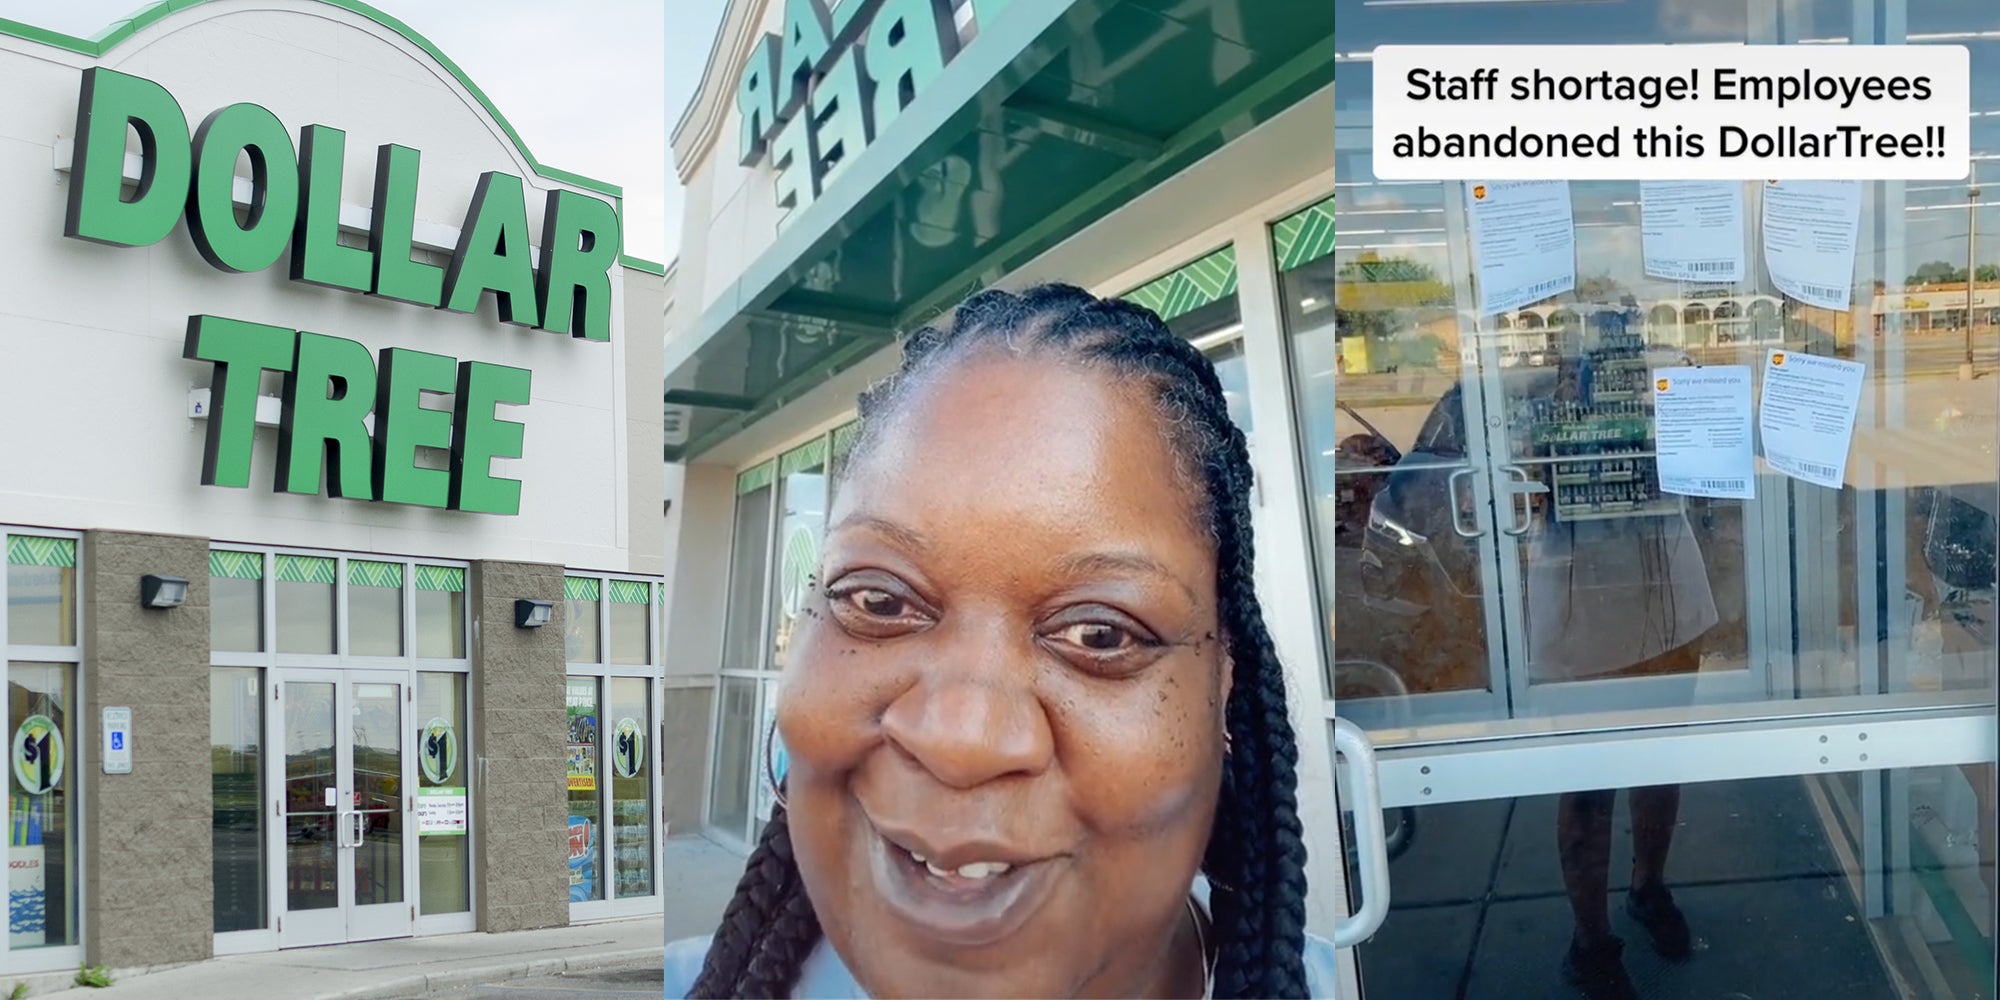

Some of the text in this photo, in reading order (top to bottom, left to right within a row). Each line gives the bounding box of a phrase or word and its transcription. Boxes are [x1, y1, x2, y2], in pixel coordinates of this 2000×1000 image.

[64, 66, 620, 343] DOLLAR
[183, 314, 532, 516] TREE
[1591, 429, 1622, 440] TREE
[24, 732, 52, 792] $1
[427, 730, 449, 782] $1
[618, 729, 637, 776] $1
